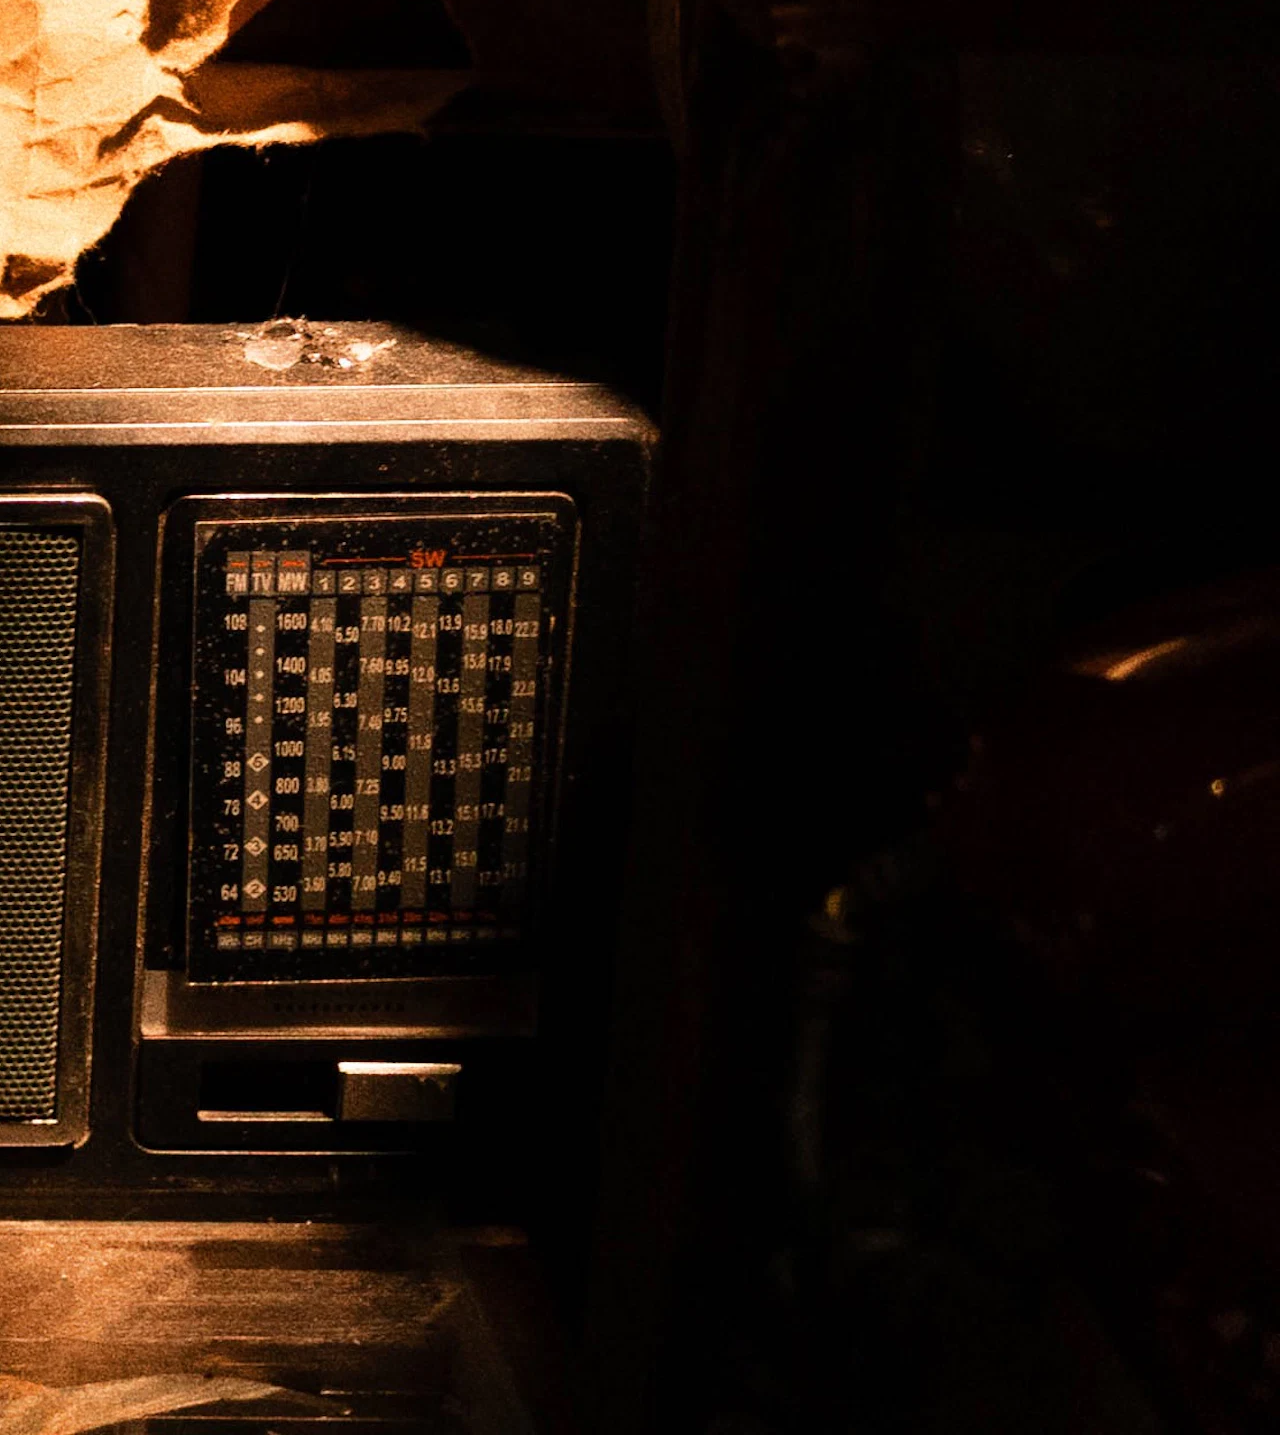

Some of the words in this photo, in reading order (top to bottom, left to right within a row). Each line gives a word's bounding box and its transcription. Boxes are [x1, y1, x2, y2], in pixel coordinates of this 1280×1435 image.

[410, 549, 449, 569] SW
[225, 572, 248, 593] FM
[251, 572, 273, 592] TV
[277, 571, 308, 592] MW
[318, 577, 329, 591] 1
[342, 576, 356, 591] 2
[368, 576, 381, 590] 3
[392, 575, 407, 589] 4
[419, 574, 433, 589] 5
[445, 573, 458, 588] 6
[471, 572, 484, 588] 7
[497, 571, 511, 587] 8
[522, 571, 536, 586] 9
[224, 613, 248, 631] 108
[277, 612, 308, 631] 1600
[387, 615, 412, 632] 10.2
[439, 613, 462, 631] 13.9
[490, 618, 514, 636] 18.0
[334, 625, 360, 644] 6.50
[463, 623, 489, 641] 15.9
[276, 656, 307, 674] 1400
[385, 658, 410, 676] 9.95
[488, 655, 513, 672] 17.9
[224, 668, 247, 686] 104
[437, 677, 460, 694] 13.6
[275, 696, 306, 715] 1200
[383, 707, 409, 724] 9.75
[274, 739, 305, 758] 1000
[484, 747, 509, 764] 17.6
[224, 760, 242, 778] 88
[433, 758, 457, 776] 13.3
[274, 776, 300, 795] 800
[223, 798, 241, 816] 78
[274, 815, 299, 833] 700
[430, 818, 454, 836] 13.2
[223, 842, 239, 862] 72
[273, 844, 299, 862] 650
[220, 882, 239, 901] 64
[272, 885, 298, 903] 530
